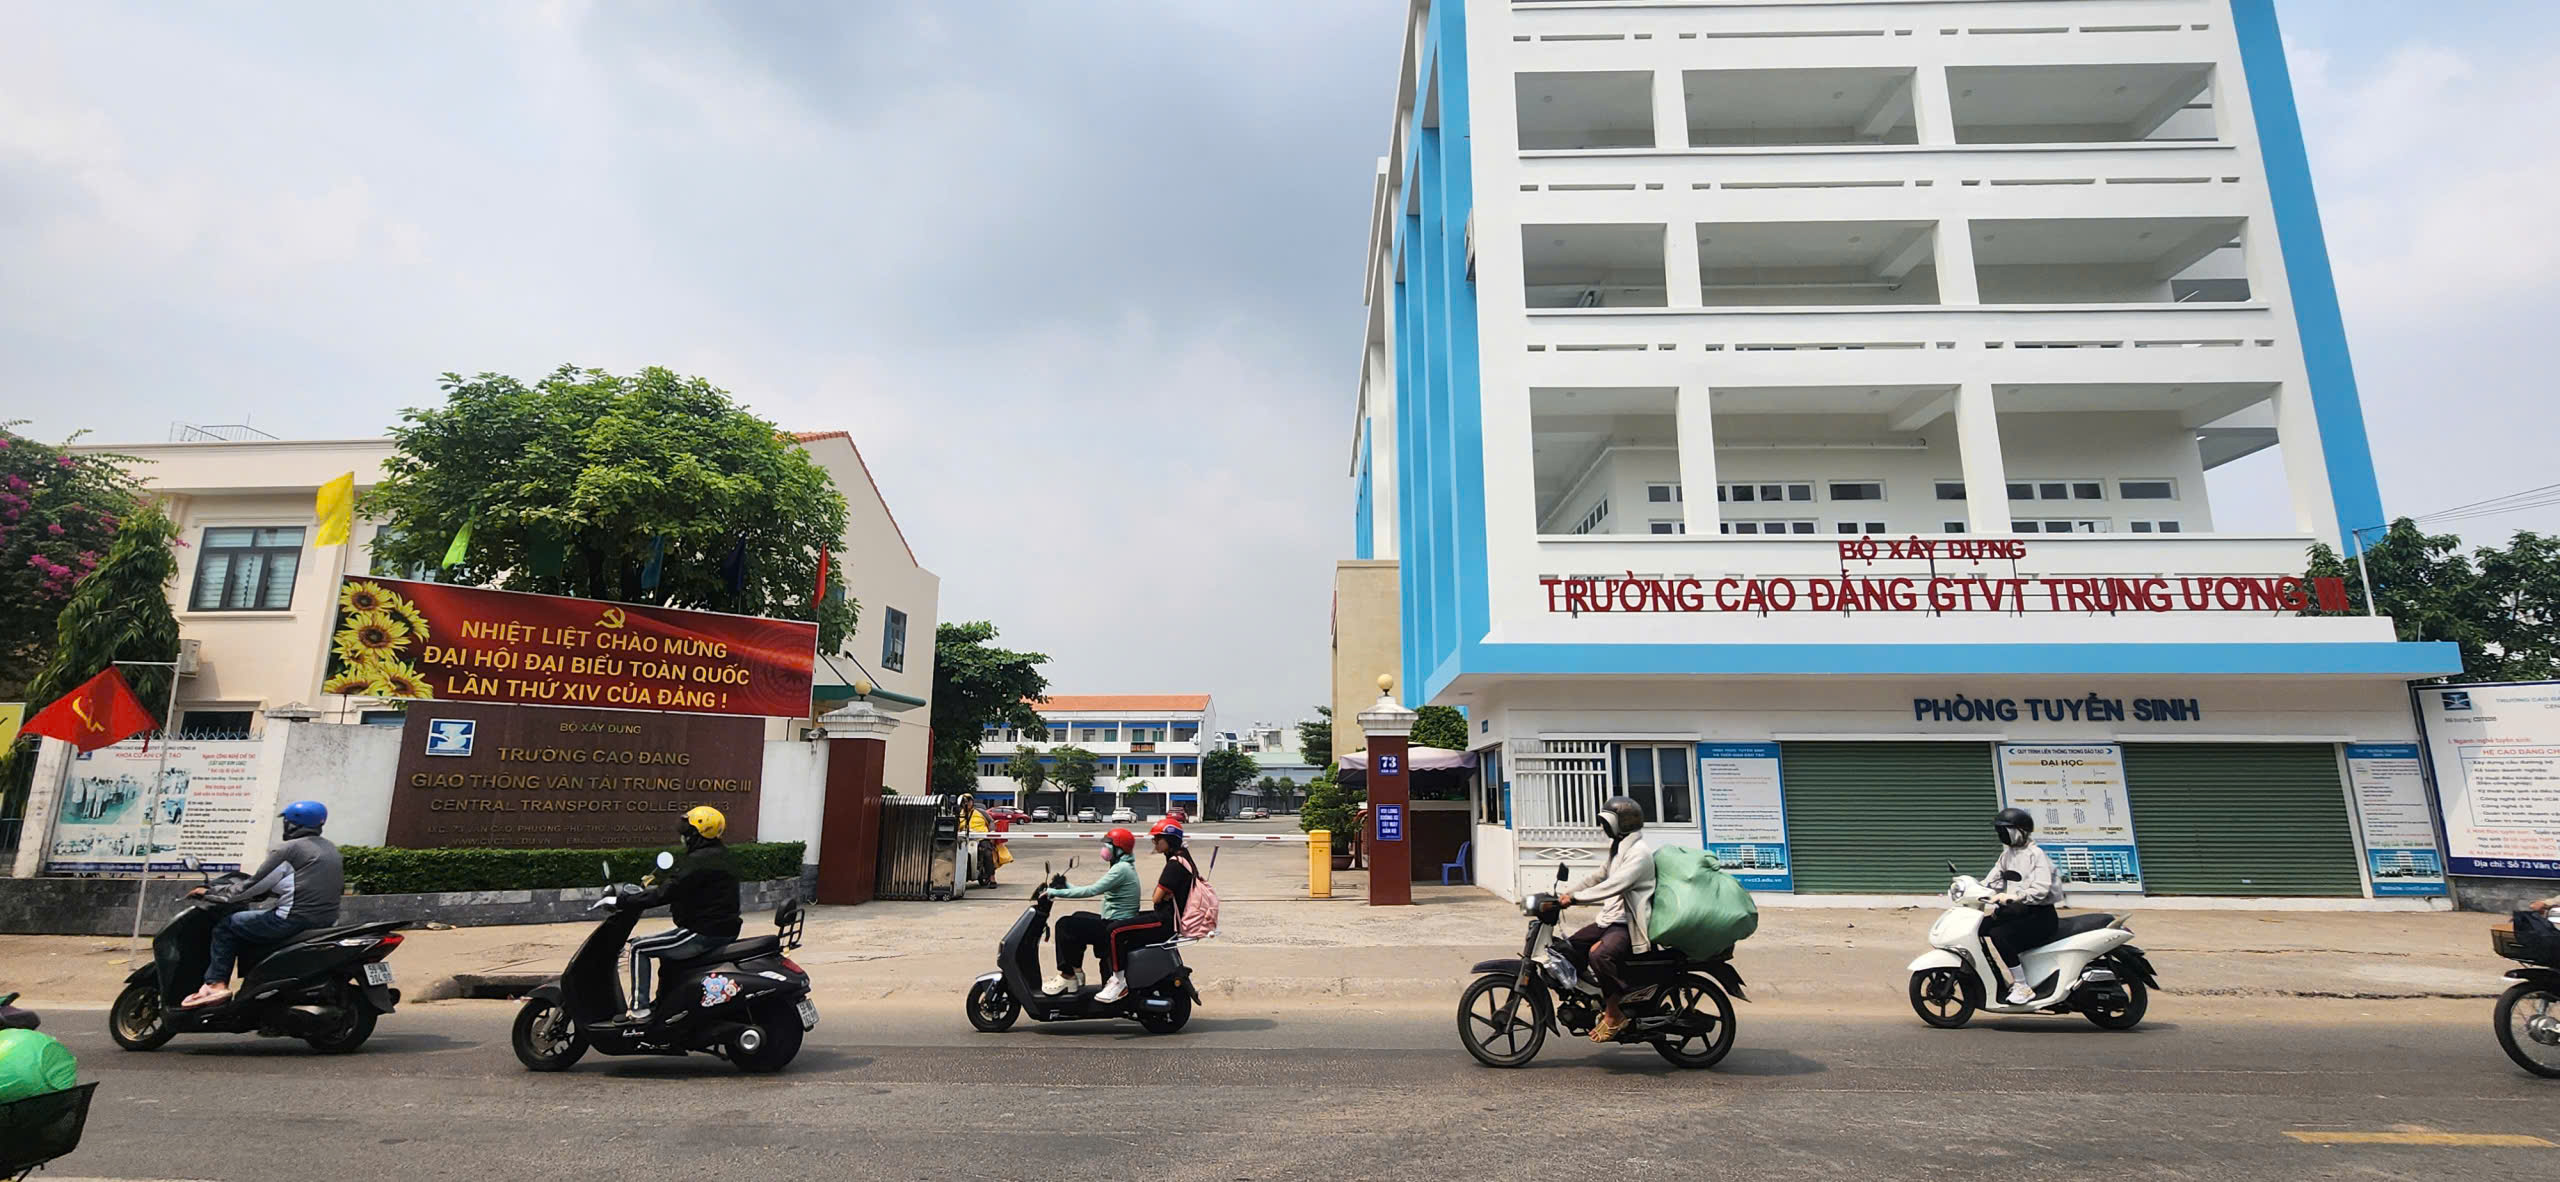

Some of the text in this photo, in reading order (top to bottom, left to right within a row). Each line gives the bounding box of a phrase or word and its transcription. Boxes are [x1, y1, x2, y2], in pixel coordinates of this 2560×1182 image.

[1839, 535, 2027, 566] BỘ XÂY DỰNG
[1540, 571, 1706, 613] TRƯỜNG
[1715, 578, 1797, 613] CAO
[1809, 569, 1918, 613] ĐẲNG
[1927, 578, 2029, 613] GTVT
[2040, 578, 2175, 613] TRUNG
[2180, 577, 2309, 613] ƯƠNG
[461, 620, 728, 659] NHIỆT LIỆT CHÀO MỪNG
[423, 645, 751, 686] ĐẠI HỘI ĐẠI BIỂU TOÀN QUỐC
[447, 671, 728, 709] LẦN THỨ XIV CỦA ĐẢNG !
[1913, 692, 2201, 722] PHÒNG TUYỂN SINH
[497, 745, 587, 763] TRƯỜNG
[593, 750, 635, 764] CAO
[1380, 756, 1398, 768] 73
[2040, 759, 2084, 768] ĐẠI HỌC
[411, 773, 466, 788] GIAO
[469, 771, 542, 790] THÔNG
[622, 777, 682, 791] TRUNG
[686, 777, 738, 792] ƯƠNG
[740, 779, 752, 792] III
[430, 799, 516, 811] CENTRAL
[520, 799, 622, 811] TRANSPORT
[2520, 861, 2532, 870] 73
